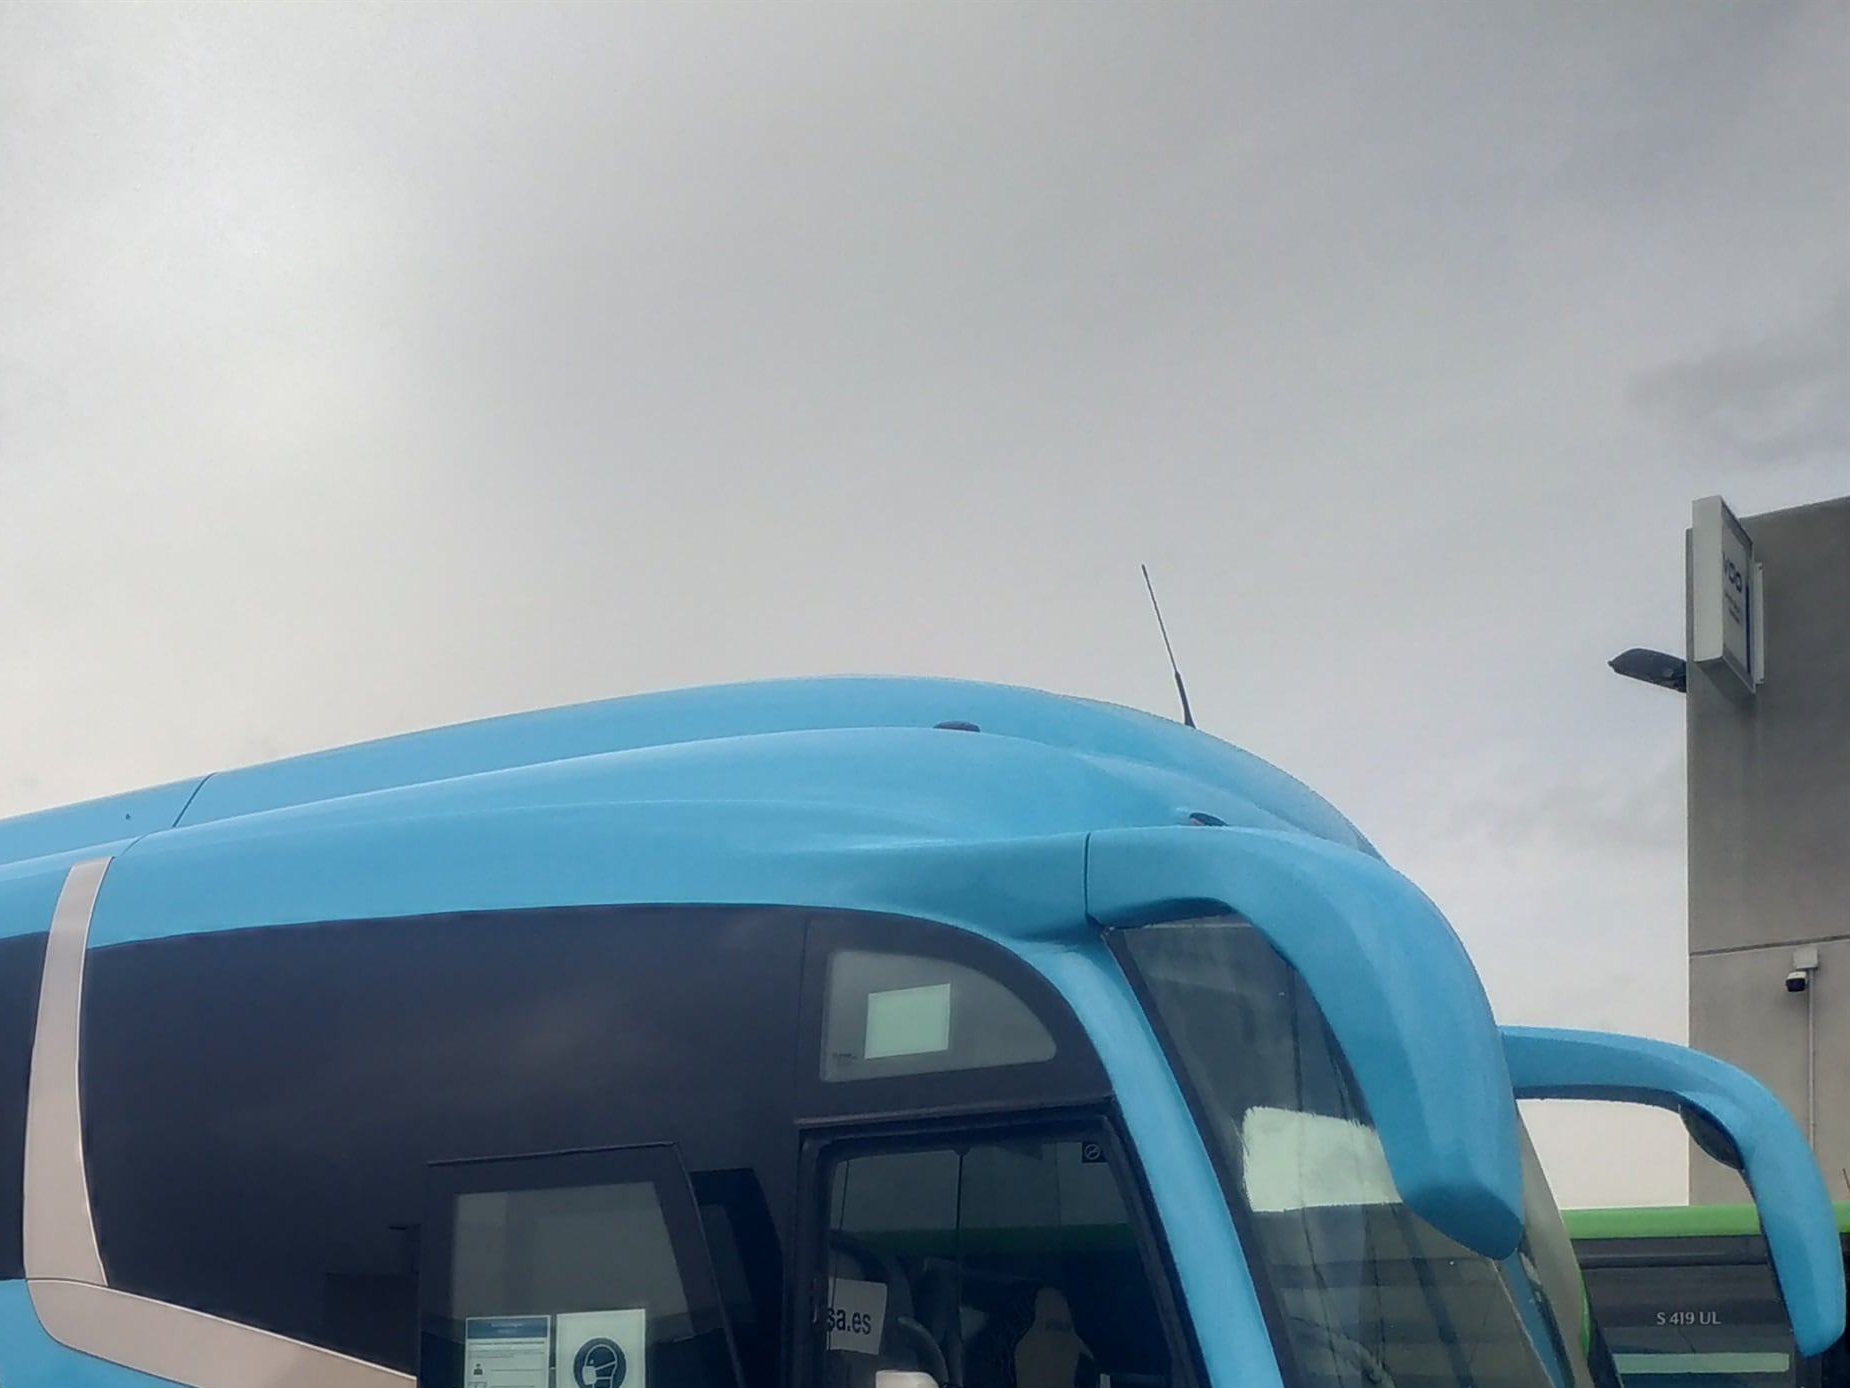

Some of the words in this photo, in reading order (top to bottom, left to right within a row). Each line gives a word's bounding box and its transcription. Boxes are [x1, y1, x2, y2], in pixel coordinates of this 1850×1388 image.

[1656, 1311, 1666, 1326] S
[1669, 1312, 1695, 1326] 419
[1699, 1311, 1722, 1326] UL
